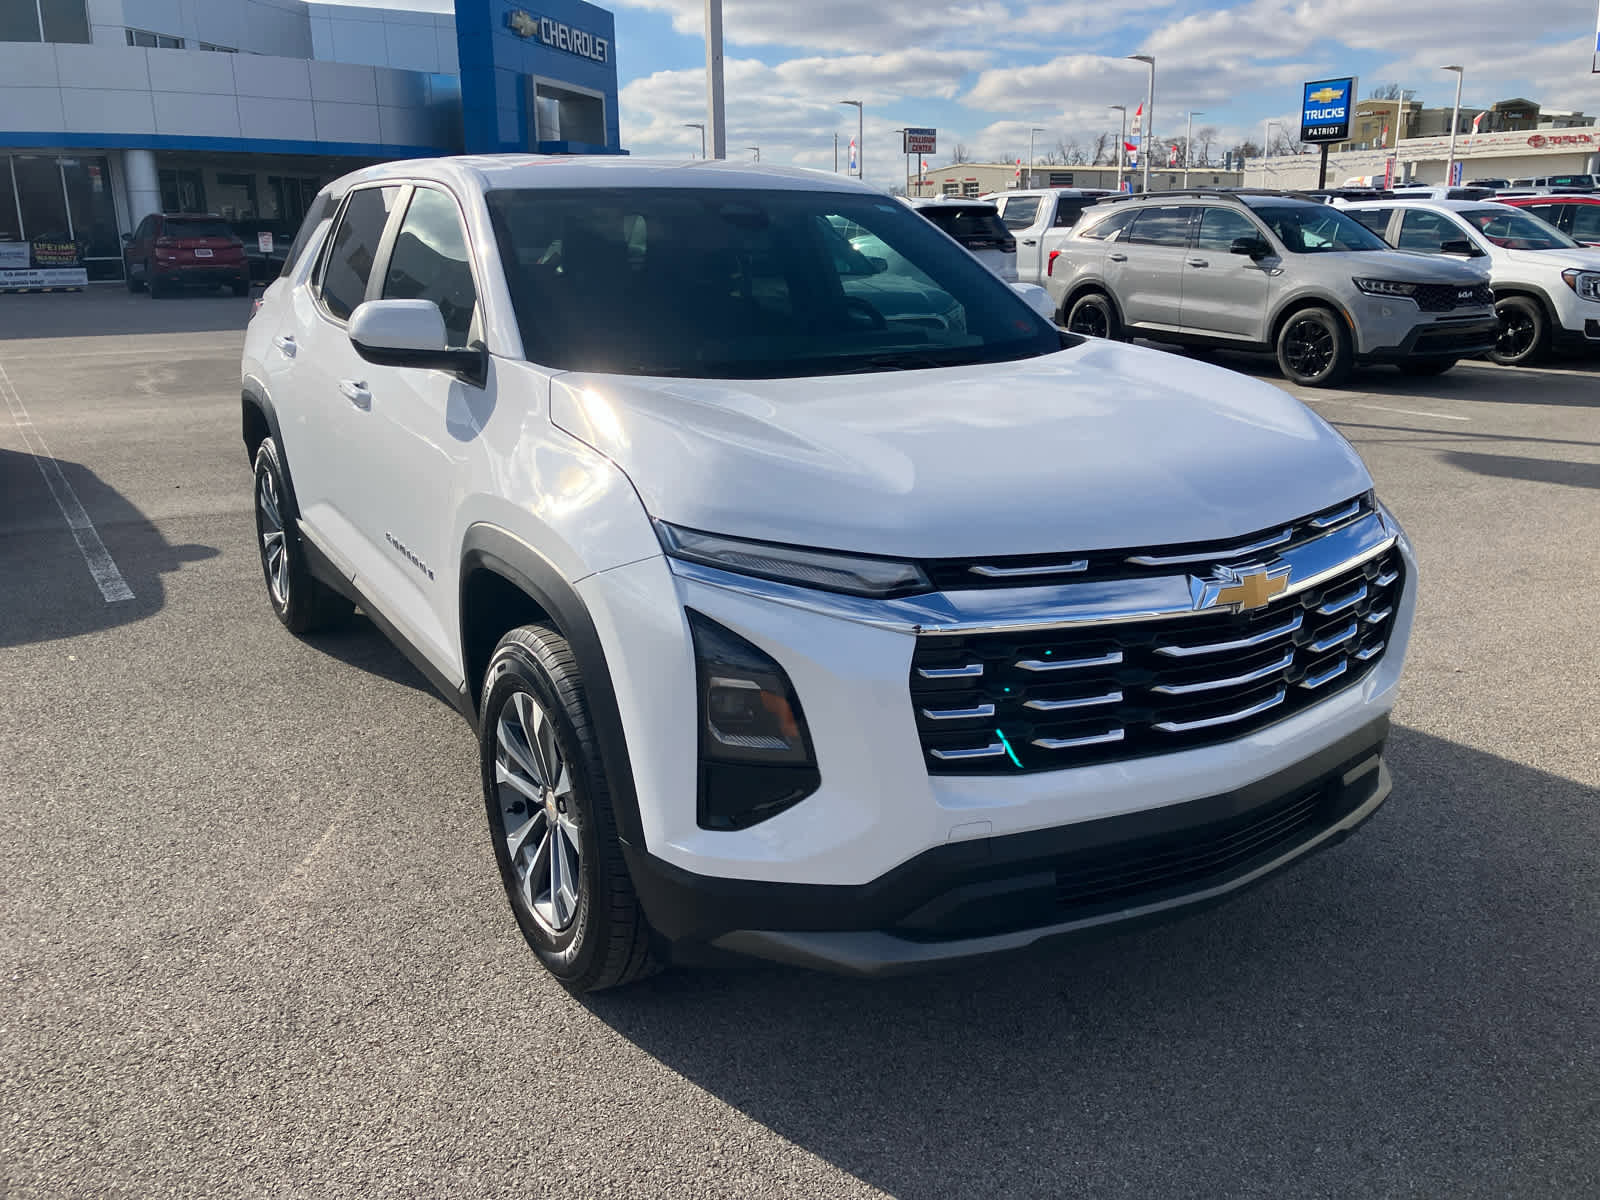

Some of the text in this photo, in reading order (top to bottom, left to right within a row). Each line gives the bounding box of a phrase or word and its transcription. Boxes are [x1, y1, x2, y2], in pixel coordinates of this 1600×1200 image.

[541, 16, 608, 63] CHEVROLET
[1305, 107, 1345, 120] TRUCKS
[1308, 126, 1340, 136] PATRIOT
